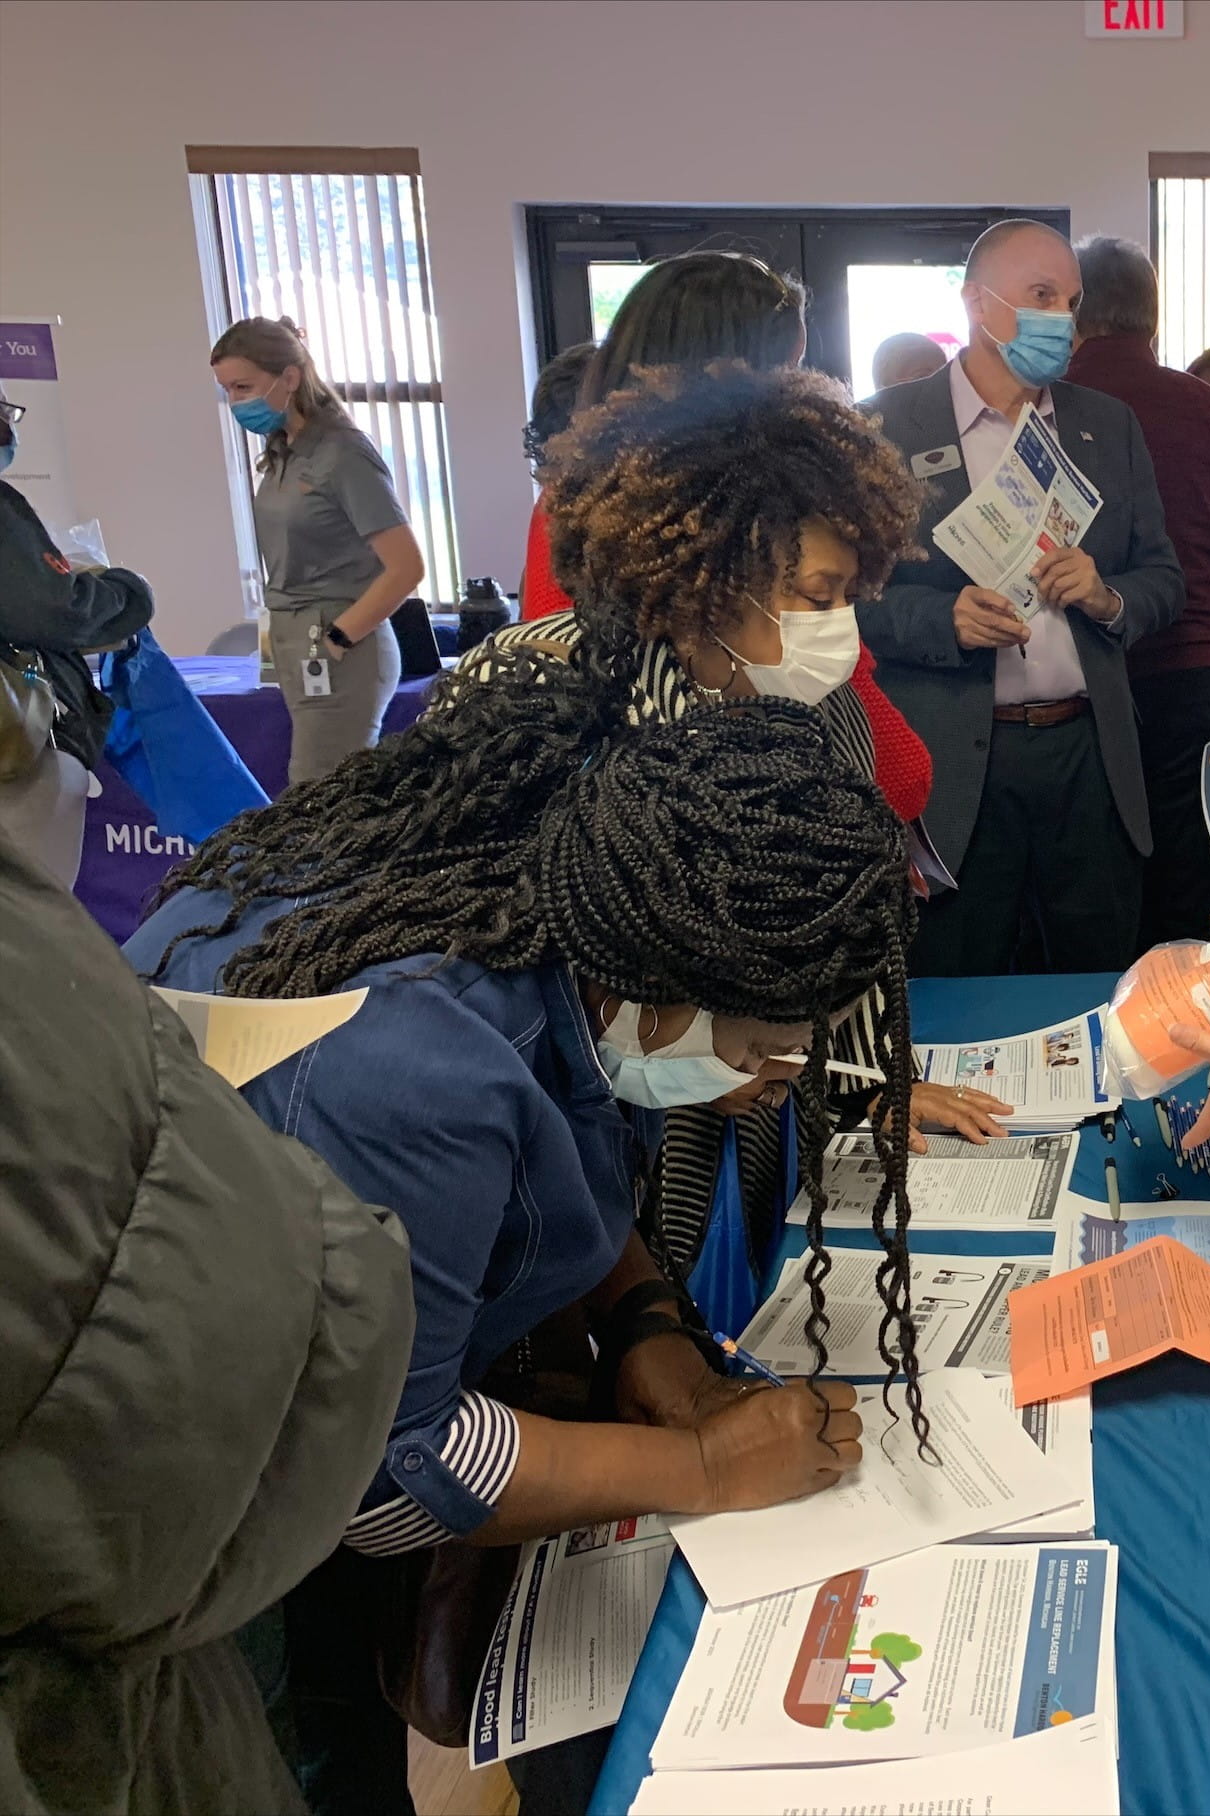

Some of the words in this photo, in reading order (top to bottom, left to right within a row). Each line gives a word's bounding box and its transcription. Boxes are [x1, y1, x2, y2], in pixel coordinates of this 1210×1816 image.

[6, 341, 37, 356] You
[1059, 1559, 1069, 1577] LEAD
[1074, 1559, 1089, 1585] EGLE
[1056, 1578, 1067, 1606] SERVICE
[1054, 1607, 1062, 1622] LINE
[1047, 1623, 1062, 1675] REPLACEMENT
[486, 1646, 502, 1685] lead
[1040, 1683, 1050, 1709] BENTON
[480, 1690, 495, 1744] Blood
